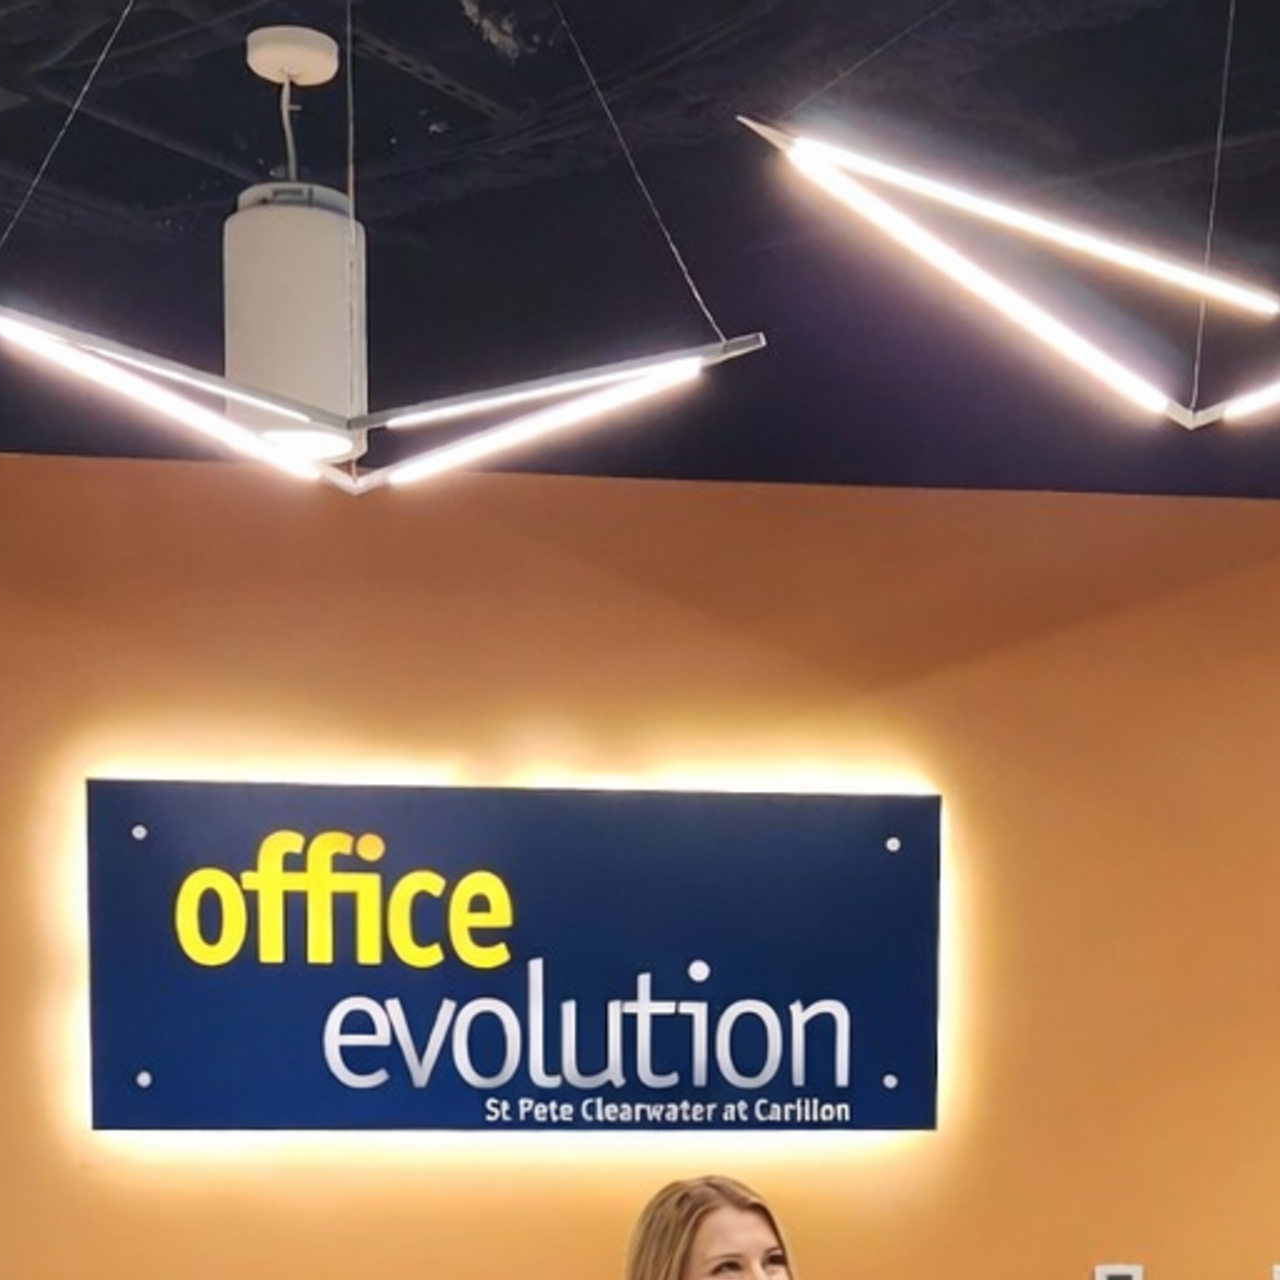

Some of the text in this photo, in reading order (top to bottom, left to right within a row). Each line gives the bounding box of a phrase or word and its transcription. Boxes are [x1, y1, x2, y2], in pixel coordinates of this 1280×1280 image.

[174, 829, 514, 969] office
[323, 957, 851, 1089] evolution
[484, 1097, 851, 1123] St Pete Clearwater at Carillon
